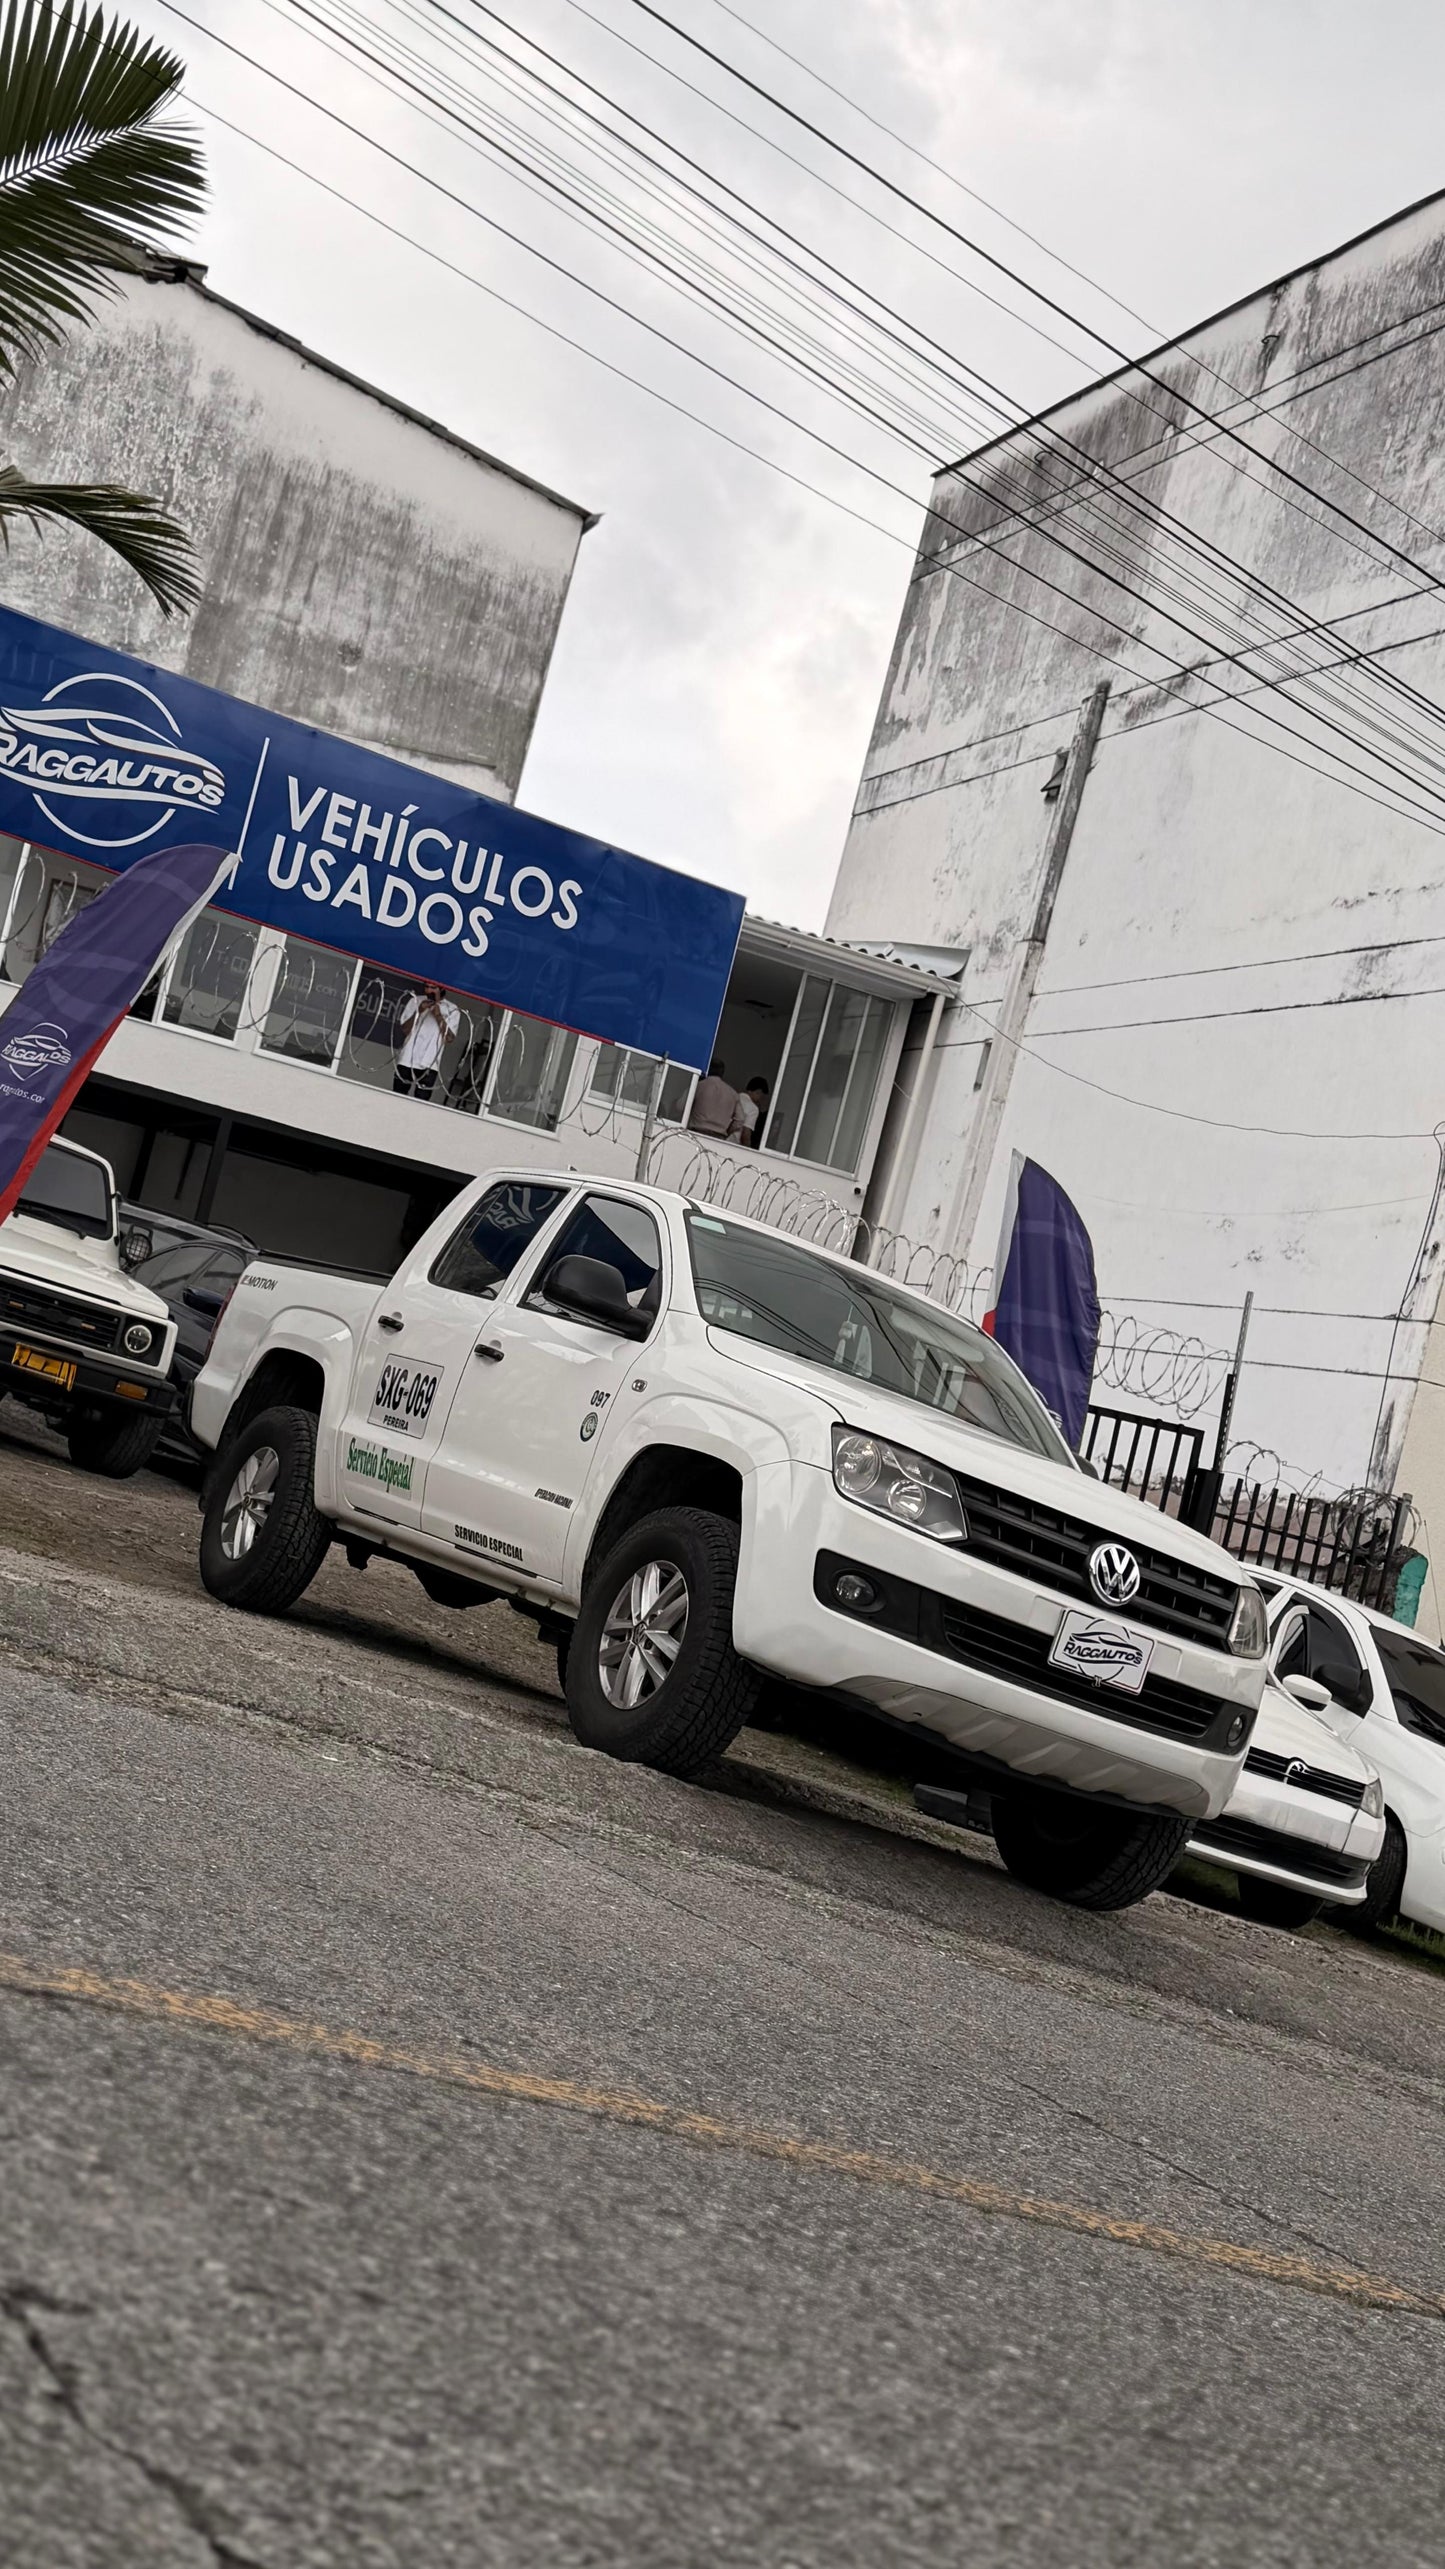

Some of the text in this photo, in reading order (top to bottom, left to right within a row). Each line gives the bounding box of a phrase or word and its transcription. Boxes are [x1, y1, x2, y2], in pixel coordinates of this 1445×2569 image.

[0, 731, 225, 806] RAGGAUTOS
[287, 775, 583, 930] VEHÍCULOS
[267, 834, 494, 957] USADOS
[375, 1364, 437, 1419] SXG-069
[590, 1390, 611, 1409] 097
[383, 1414, 409, 1431] PEREIRA
[347, 1437, 414, 1493] Servicio Especial
[454, 1524, 524, 1562] SERVICIO ESPECIAL
[1063, 1641, 1143, 1666] RAGGAUTOS
